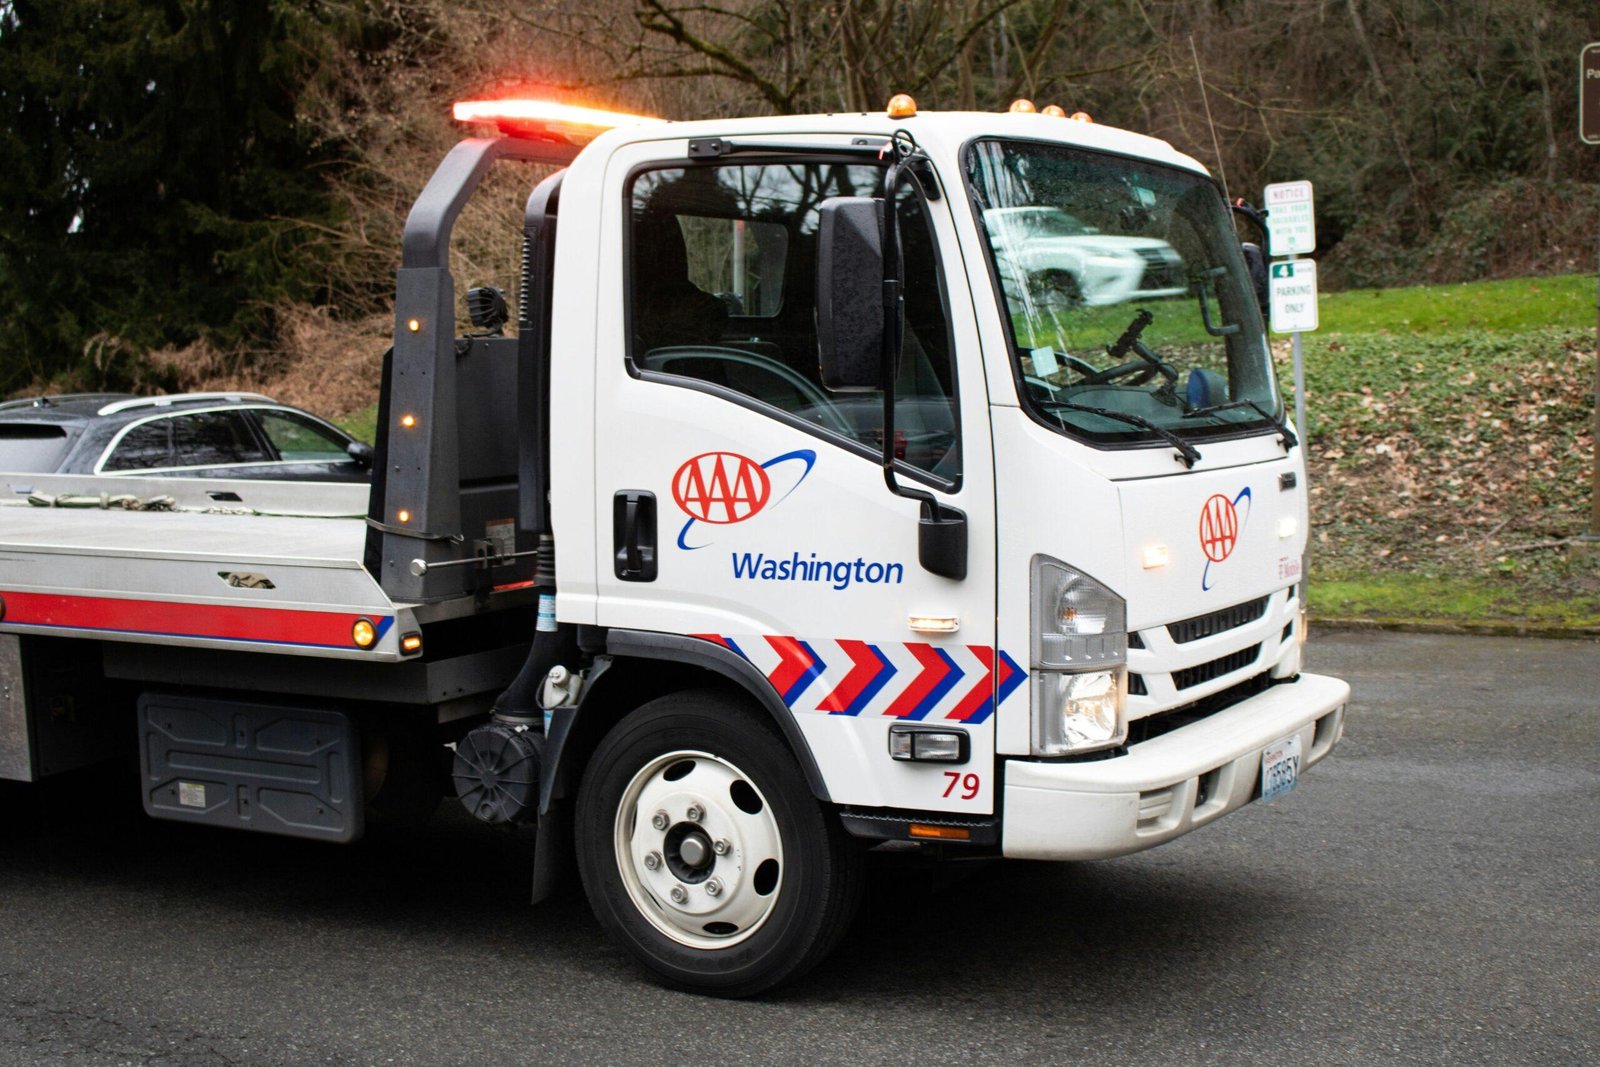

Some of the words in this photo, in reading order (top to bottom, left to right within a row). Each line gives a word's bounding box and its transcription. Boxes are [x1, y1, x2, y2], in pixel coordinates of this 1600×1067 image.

[1273, 187, 1305, 199] NOTICE
[1277, 284, 1312, 296] PARKING
[1285, 302, 1305, 314] ONLY
[677, 453, 764, 522] AAA
[1200, 494, 1237, 562] AAA
[732, 552, 904, 590] Washington
[942, 771, 980, 800] 79
